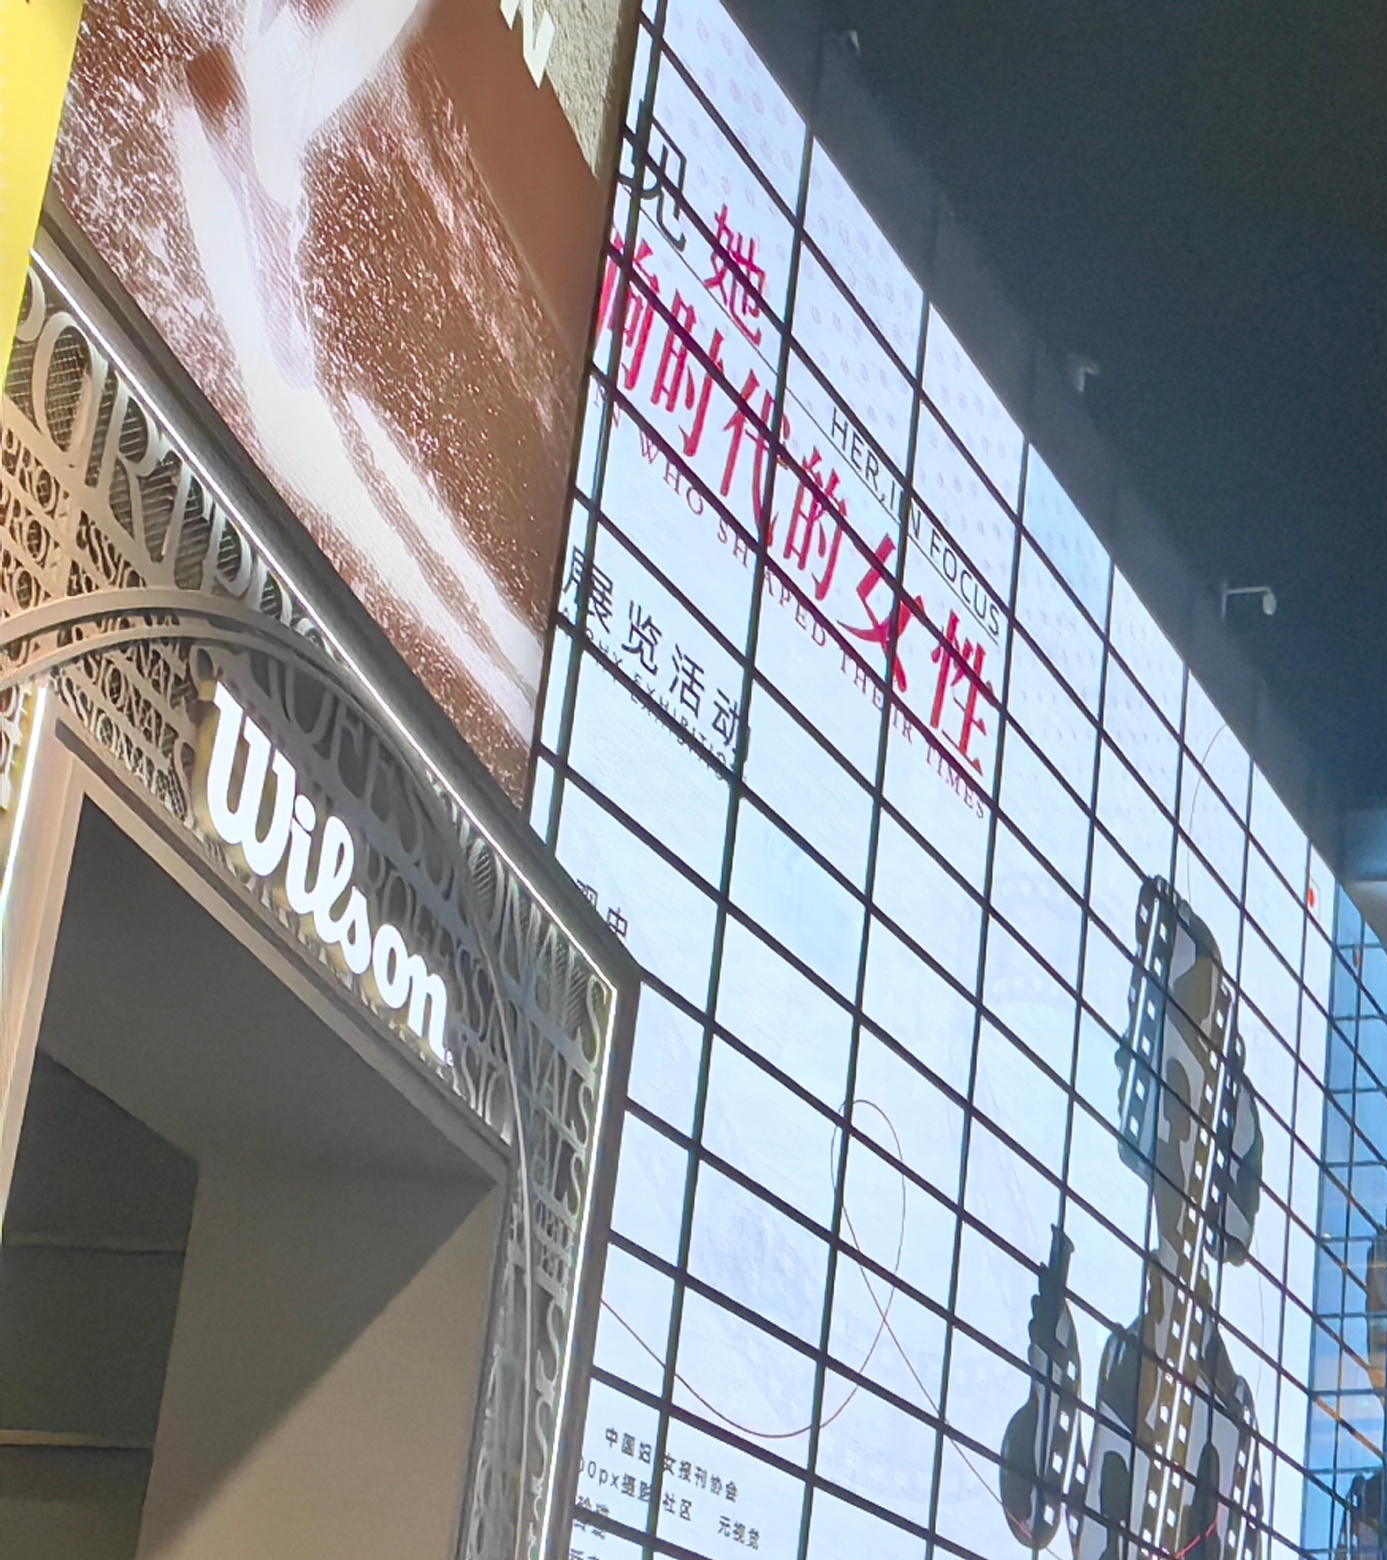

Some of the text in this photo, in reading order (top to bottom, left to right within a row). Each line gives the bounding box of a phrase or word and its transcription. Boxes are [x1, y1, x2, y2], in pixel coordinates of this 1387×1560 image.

[562, 545, 751, 747] 展览活动
[930, 529, 1001, 637] FOCUS
[206, 680, 450, 1061] Wilson
